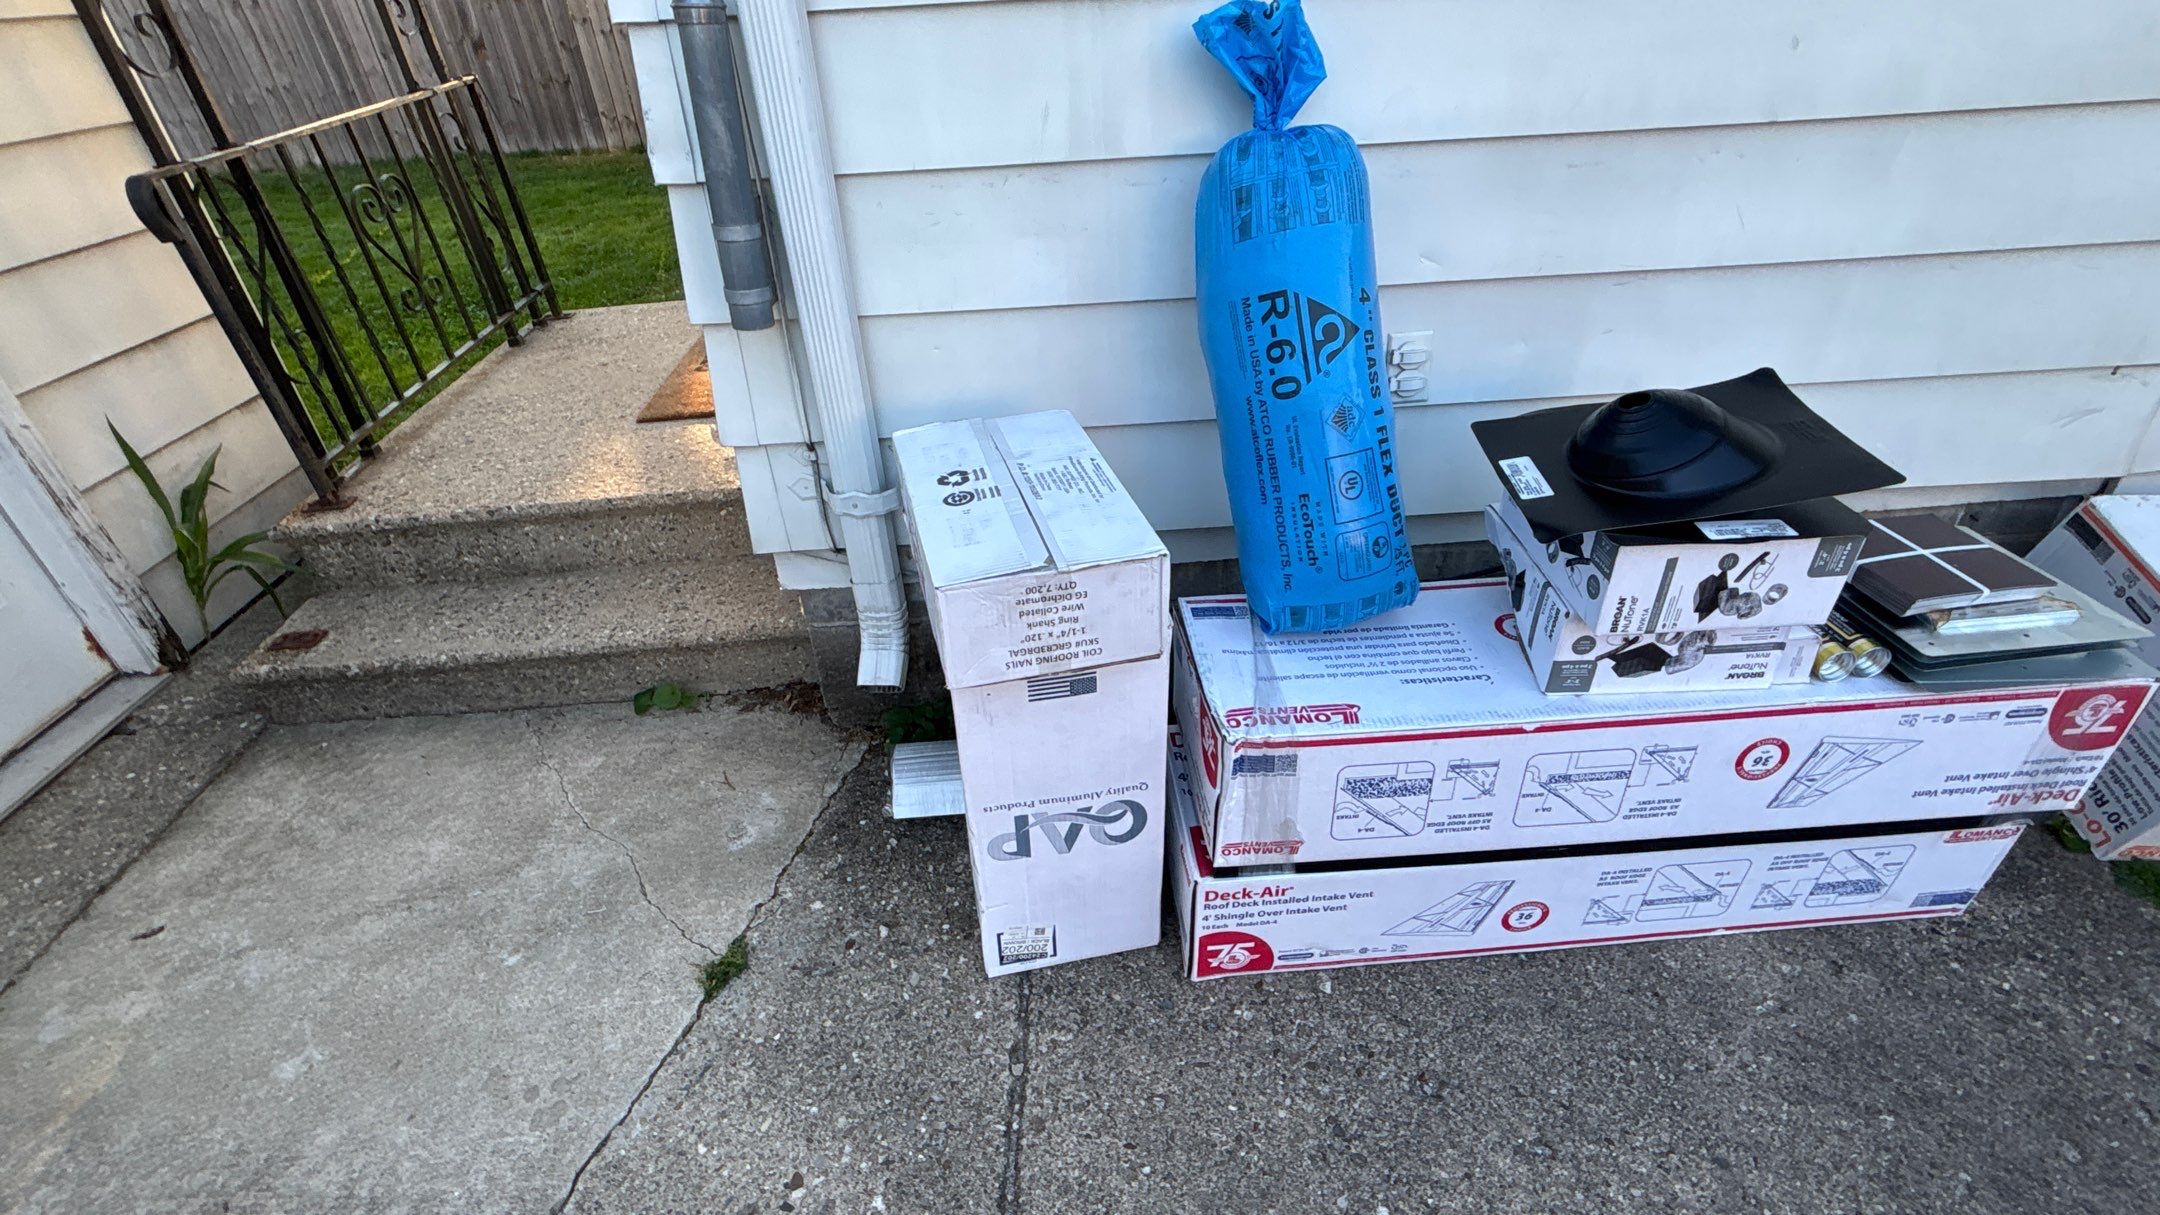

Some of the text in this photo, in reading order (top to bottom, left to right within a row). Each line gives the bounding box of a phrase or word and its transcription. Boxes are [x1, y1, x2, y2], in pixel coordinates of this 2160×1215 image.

[1257, 289, 1302, 400] R-6.0
[1346, 405, 1356, 428] adc
[1364, 329, 1405, 537] CLASS 1 FLEX DUCT
[1241, 297, 1292, 593] Made in USA by ATCO RUBBER PRODUCTS, Inc.
[1246, 396, 1268, 504] www.atcoflex.com
[1345, 476, 1358, 495] UL
[1291, 502, 1304, 562] INSULATION
[1320, 532, 1328, 557] WITH
[1025, 581, 1077, 596] QTY: 7,200
[1016, 591, 1088, 606] EG Dichromate
[1018, 603, 1085, 620] Wire Collated
[1610, 596, 1627, 634] BROAN
[1026, 616, 1079, 630] Ring Shank
[1411, 622, 1450, 630] Garantía
[1548, 607, 1561, 640] BROAN
[1636, 608, 1650, 632] RVK1A
[1374, 624, 1410, 632] limitada
[1416, 630, 1442, 638] ajusta
[1360, 632, 1408, 642] pendientes
[1008, 638, 1100, 658] SKU# GRCR3DRGAL
[1298, 645, 1344, 654] protección
[1364, 642, 1396, 650] brindar
[1421, 648, 1440, 656] bajo
[1005, 648, 1104, 670] COIL ROOFING NAILS
[1401, 657, 1440, 666] anillados
[1338, 670, 1390, 679] ventilación
[1420, 666, 1458, 675] opcional
[1728, 672, 1765, 680] BROAN
[1258, 706, 1310, 714] VENTS
[1225, 711, 1360, 728] LOMANCO
[1751, 755, 1774, 768] 36
[1973, 770, 2010, 780] Intake
[2012, 768, 2038, 778] Over
[2041, 764, 2084, 776] Shingle
[1944, 774, 1970, 782] Vent
[1912, 778, 2088, 798] Roof Deck Installed Intake Vent
[2108, 769, 2148, 820] Low-Profile
[983, 782, 1148, 814] Quality Aluminum Products
[987, 799, 1148, 861] QAP
[1434, 826, 1472, 834] INSTALLED
[2102, 811, 2129, 834] 30'
[1221, 844, 1300, 856] LOMANCO
[1244, 840, 1274, 848] VENTS
[1204, 884, 1290, 902] Deck-Air
[1204, 890, 1375, 910] Roof Deck Installed Intake Vent
[1202, 904, 1348, 923] 4' Shingle Over Intake Vent
[1515, 912, 1534, 922] 36
[1236, 920, 1259, 928] Model
[1001, 944, 1048, 954] 200/202
[1207, 942, 1257, 970] 75
